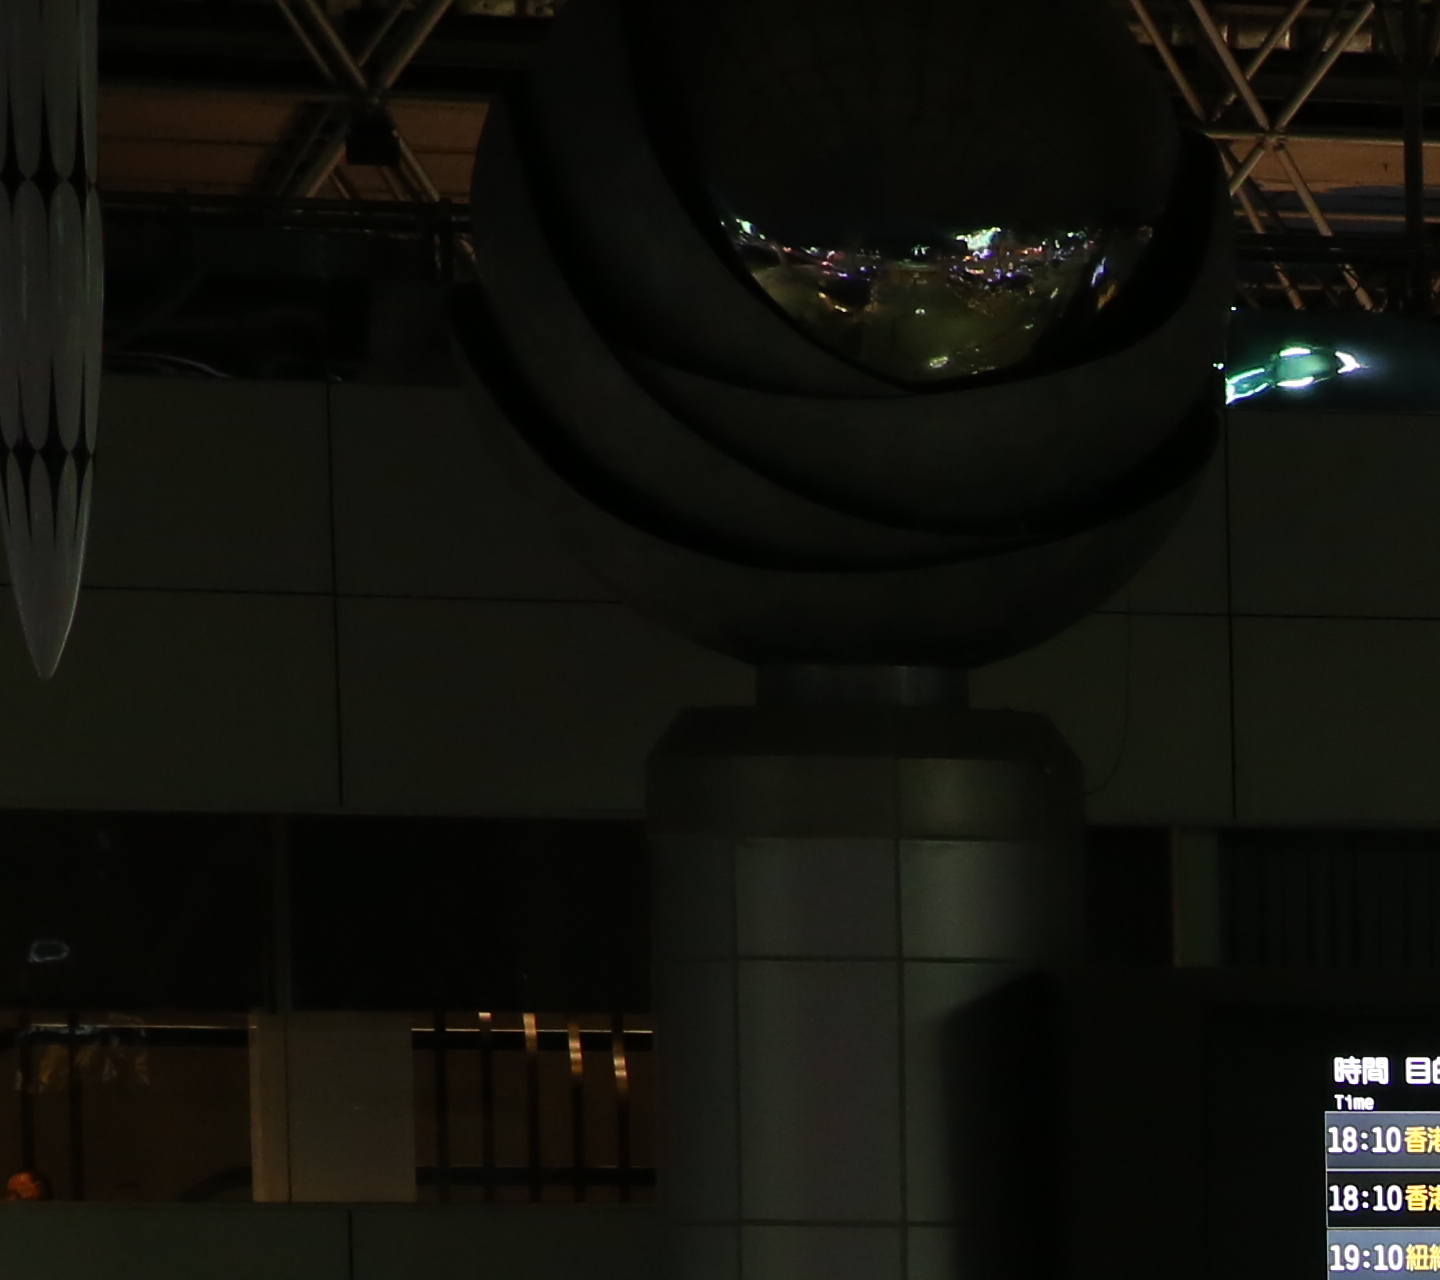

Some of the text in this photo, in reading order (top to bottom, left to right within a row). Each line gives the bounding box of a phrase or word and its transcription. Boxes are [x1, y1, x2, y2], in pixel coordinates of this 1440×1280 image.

[1334, 1056, 1388, 1084] 時間
[1334, 1094, 1374, 1110] Time
[1328, 1127, 1401, 1152] 18:10
